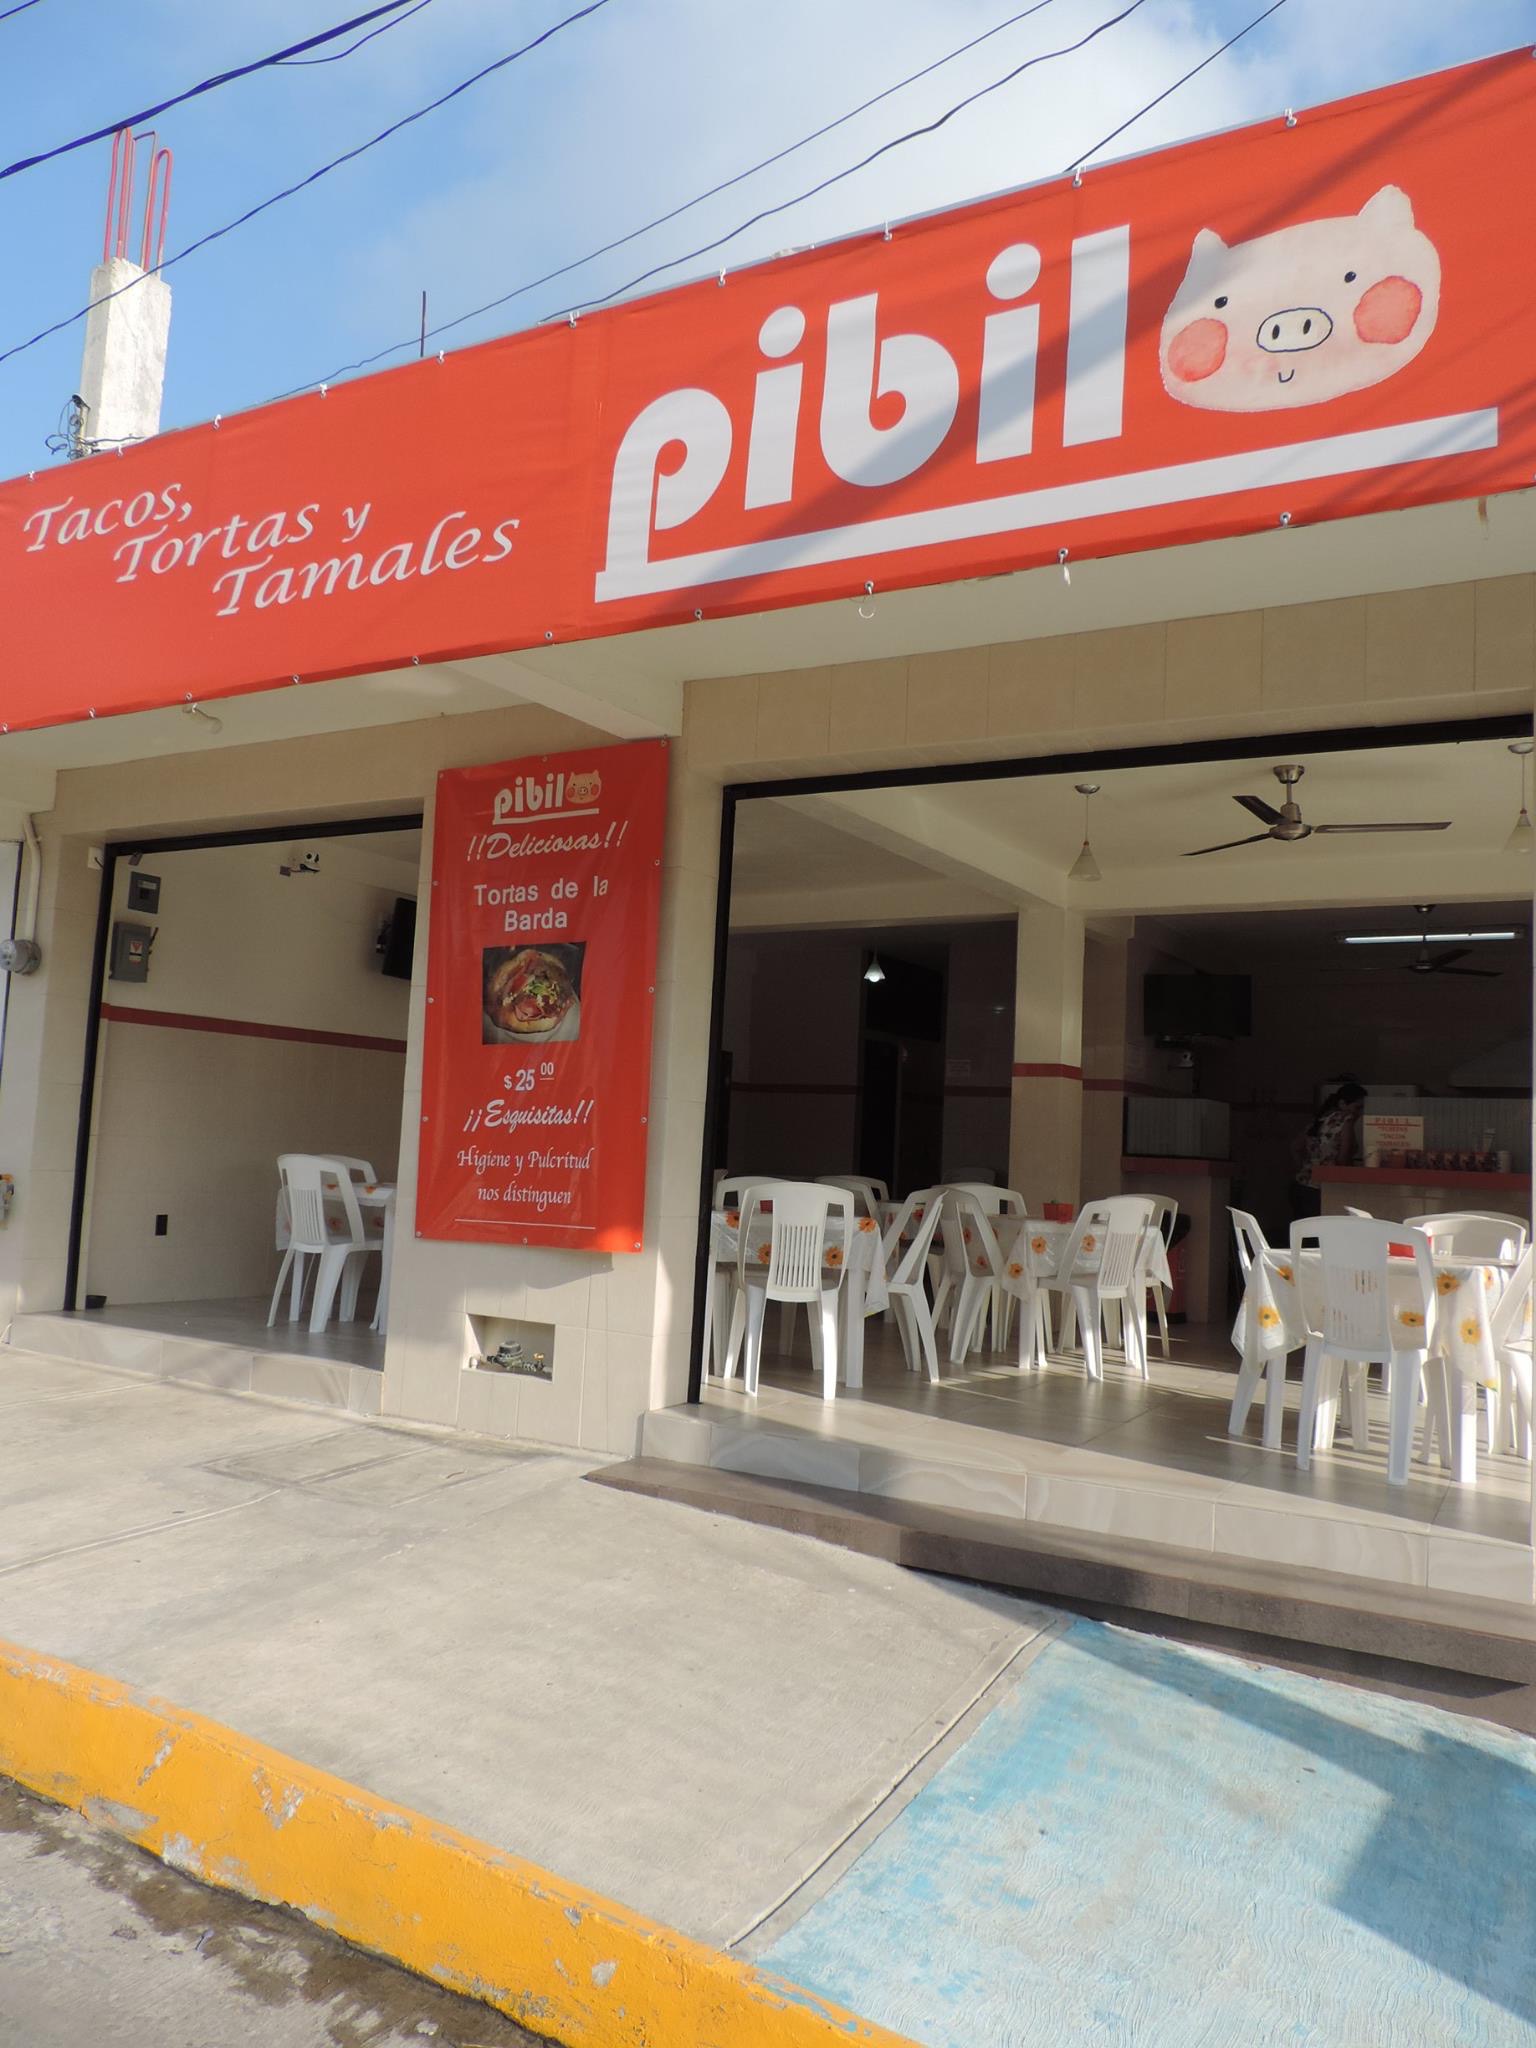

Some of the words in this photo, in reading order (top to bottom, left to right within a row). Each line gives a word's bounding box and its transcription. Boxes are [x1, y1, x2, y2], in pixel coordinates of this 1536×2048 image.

[594, 224, 1131, 603] pibil
[23, 483, 192, 552] Tacos,
[113, 503, 320, 583] Tortas
[341, 503, 371, 543] y
[212, 511, 520, 616] Tamales
[492, 773, 565, 825] pibil
[474, 884, 538, 906] Tortas
[551, 878, 578, 899] de
[593, 875, 608, 896] la
[504, 907, 567, 932] Barda
[457, 1145, 510, 1175] Higiene
[514, 1155, 524, 1176] y
[528, 1147, 595, 1169] Pulcritud
[477, 1188, 499, 1201] nos
[503, 1181, 572, 1212] distinguen
